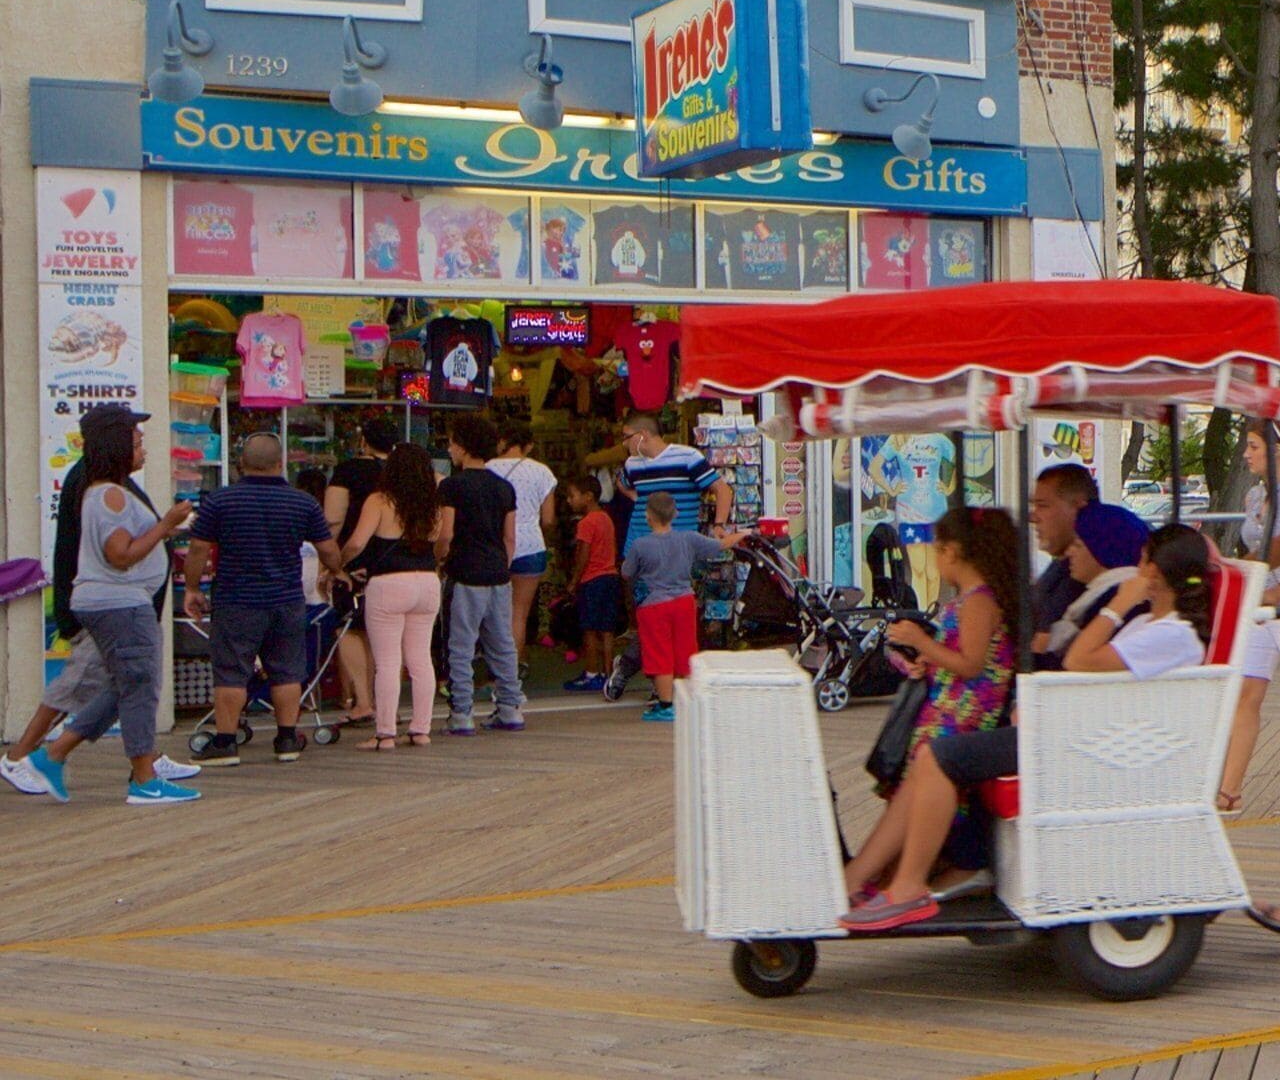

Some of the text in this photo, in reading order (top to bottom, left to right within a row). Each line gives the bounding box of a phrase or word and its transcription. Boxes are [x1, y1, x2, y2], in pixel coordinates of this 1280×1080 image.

[227, 54, 289, 77] 1239
[682, 87, 714, 119] Gifts &
[658, 106, 737, 162] Souvenirs
[174, 107, 429, 161] Souvenirs
[883, 155, 987, 195] Gifts
[62, 230, 118, 245] TOYS
[77, 245, 124, 253] NOVELTIES
[42, 253, 138, 269] JEWELRY
[63, 283, 119, 294] HERMIT
[67, 296, 115, 306] CRABS
[47, 384, 137, 398] T-SHIRTS
[55, 401, 72, 415] &
